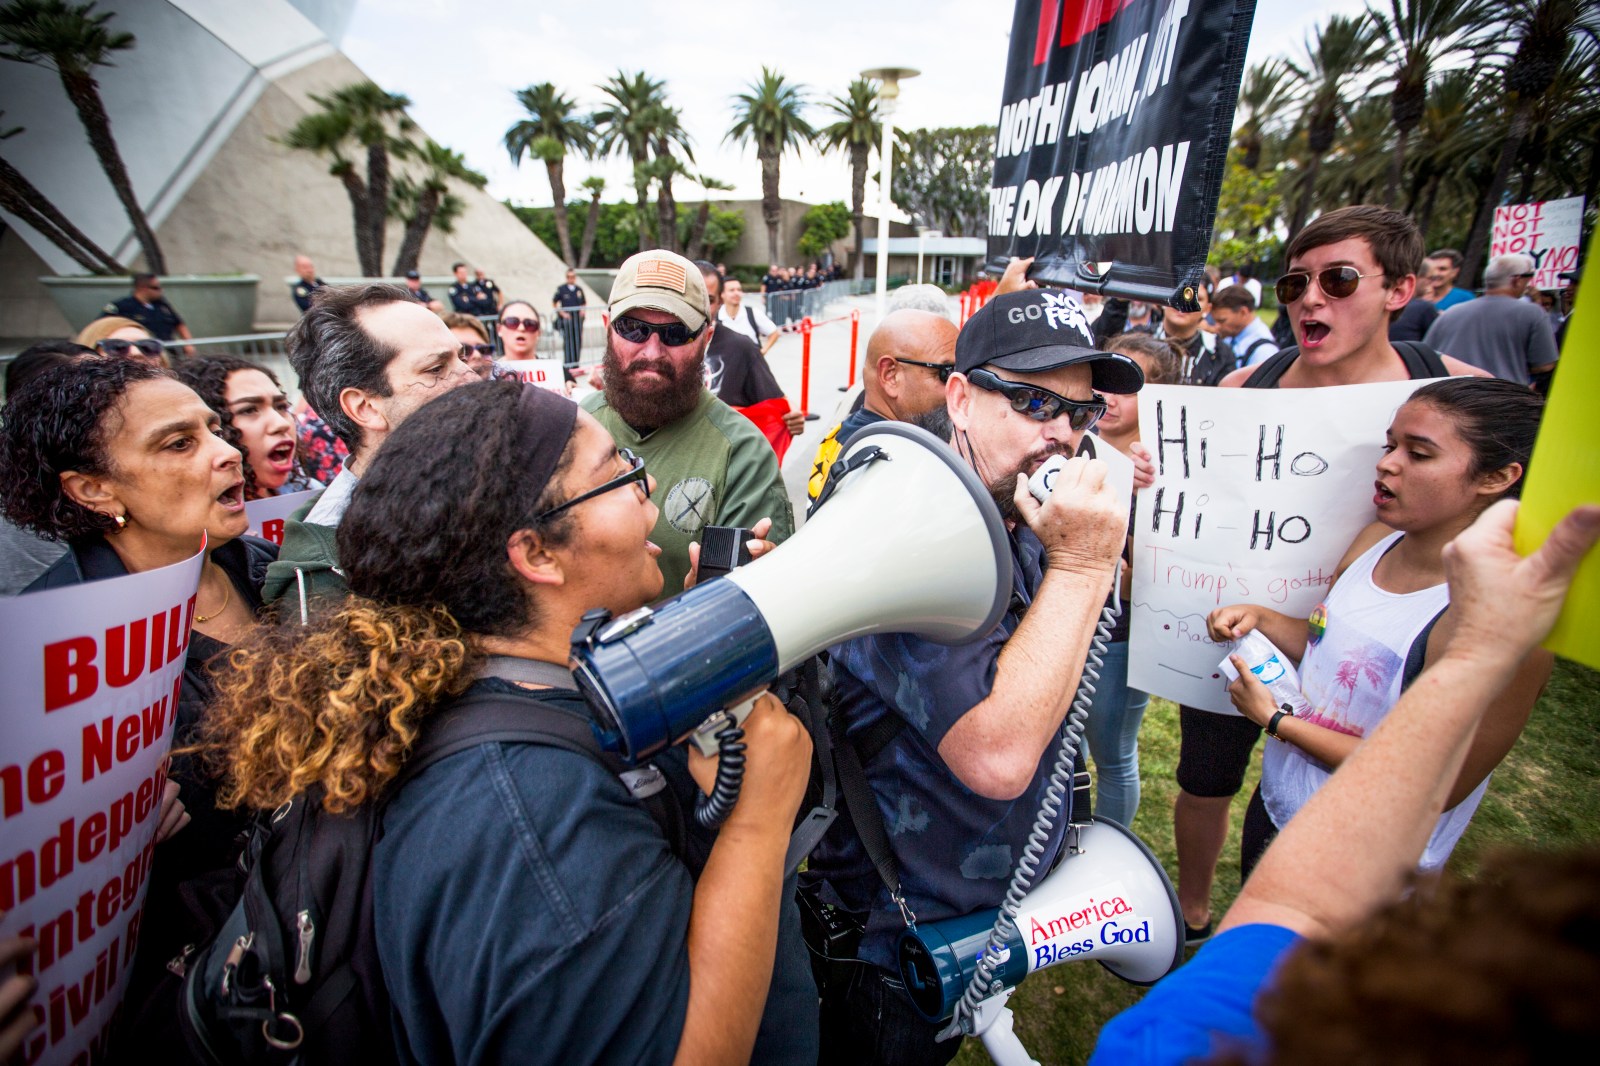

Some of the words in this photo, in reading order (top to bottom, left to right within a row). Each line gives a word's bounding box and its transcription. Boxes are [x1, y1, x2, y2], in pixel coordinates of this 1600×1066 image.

[1494, 218, 1544, 240] NOT
[1495, 201, 1547, 223] NOT
[1491, 233, 1545, 257] NOT
[1145, 544, 1250, 605] Trump's
[82, 694, 169, 784] New
[1031, 896, 1133, 945] America,
[1034, 938, 1094, 971] Bless
[1100, 920, 1151, 945] God
